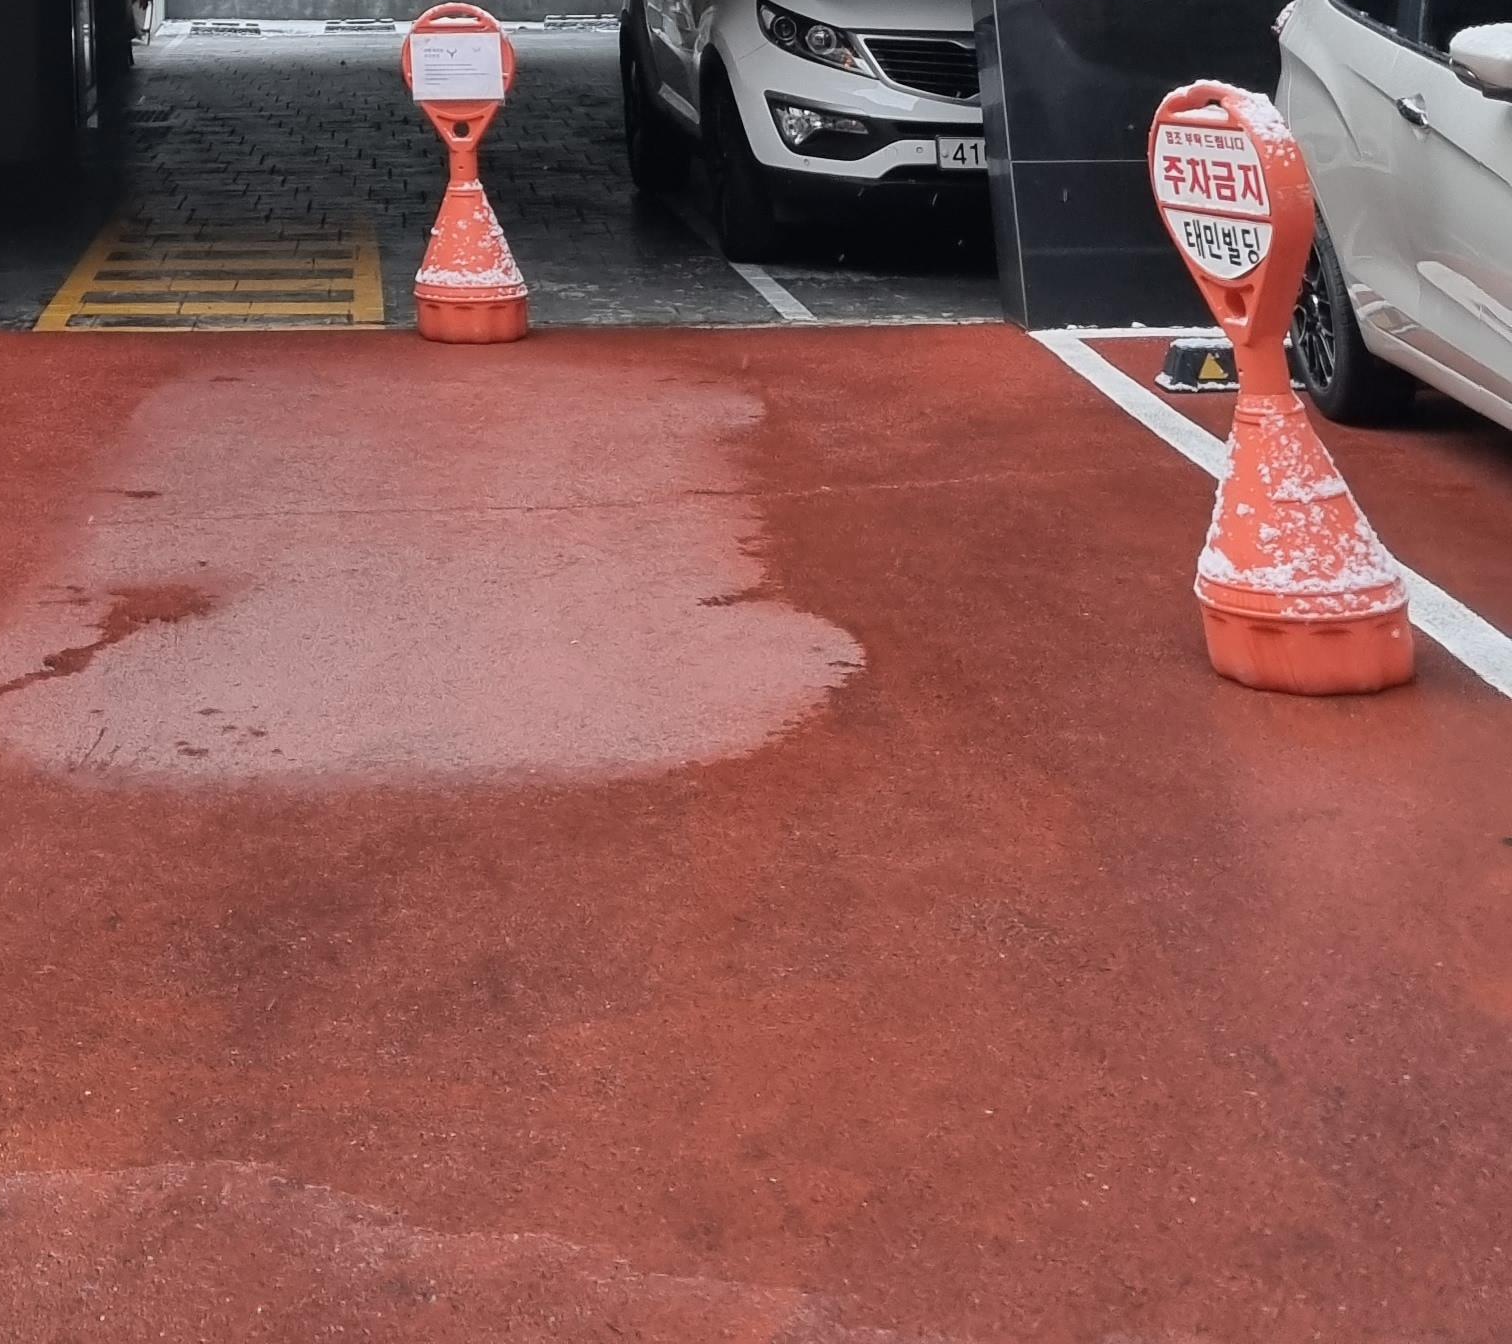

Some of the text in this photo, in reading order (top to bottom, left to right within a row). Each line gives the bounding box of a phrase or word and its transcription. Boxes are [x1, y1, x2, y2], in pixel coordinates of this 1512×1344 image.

[952, 142, 987, 165] 41
[1203, 134, 1245, 152] 드립니다
[1162, 155, 1264, 206] 주차금지
[1183, 219, 1261, 266] 태민빌딩
